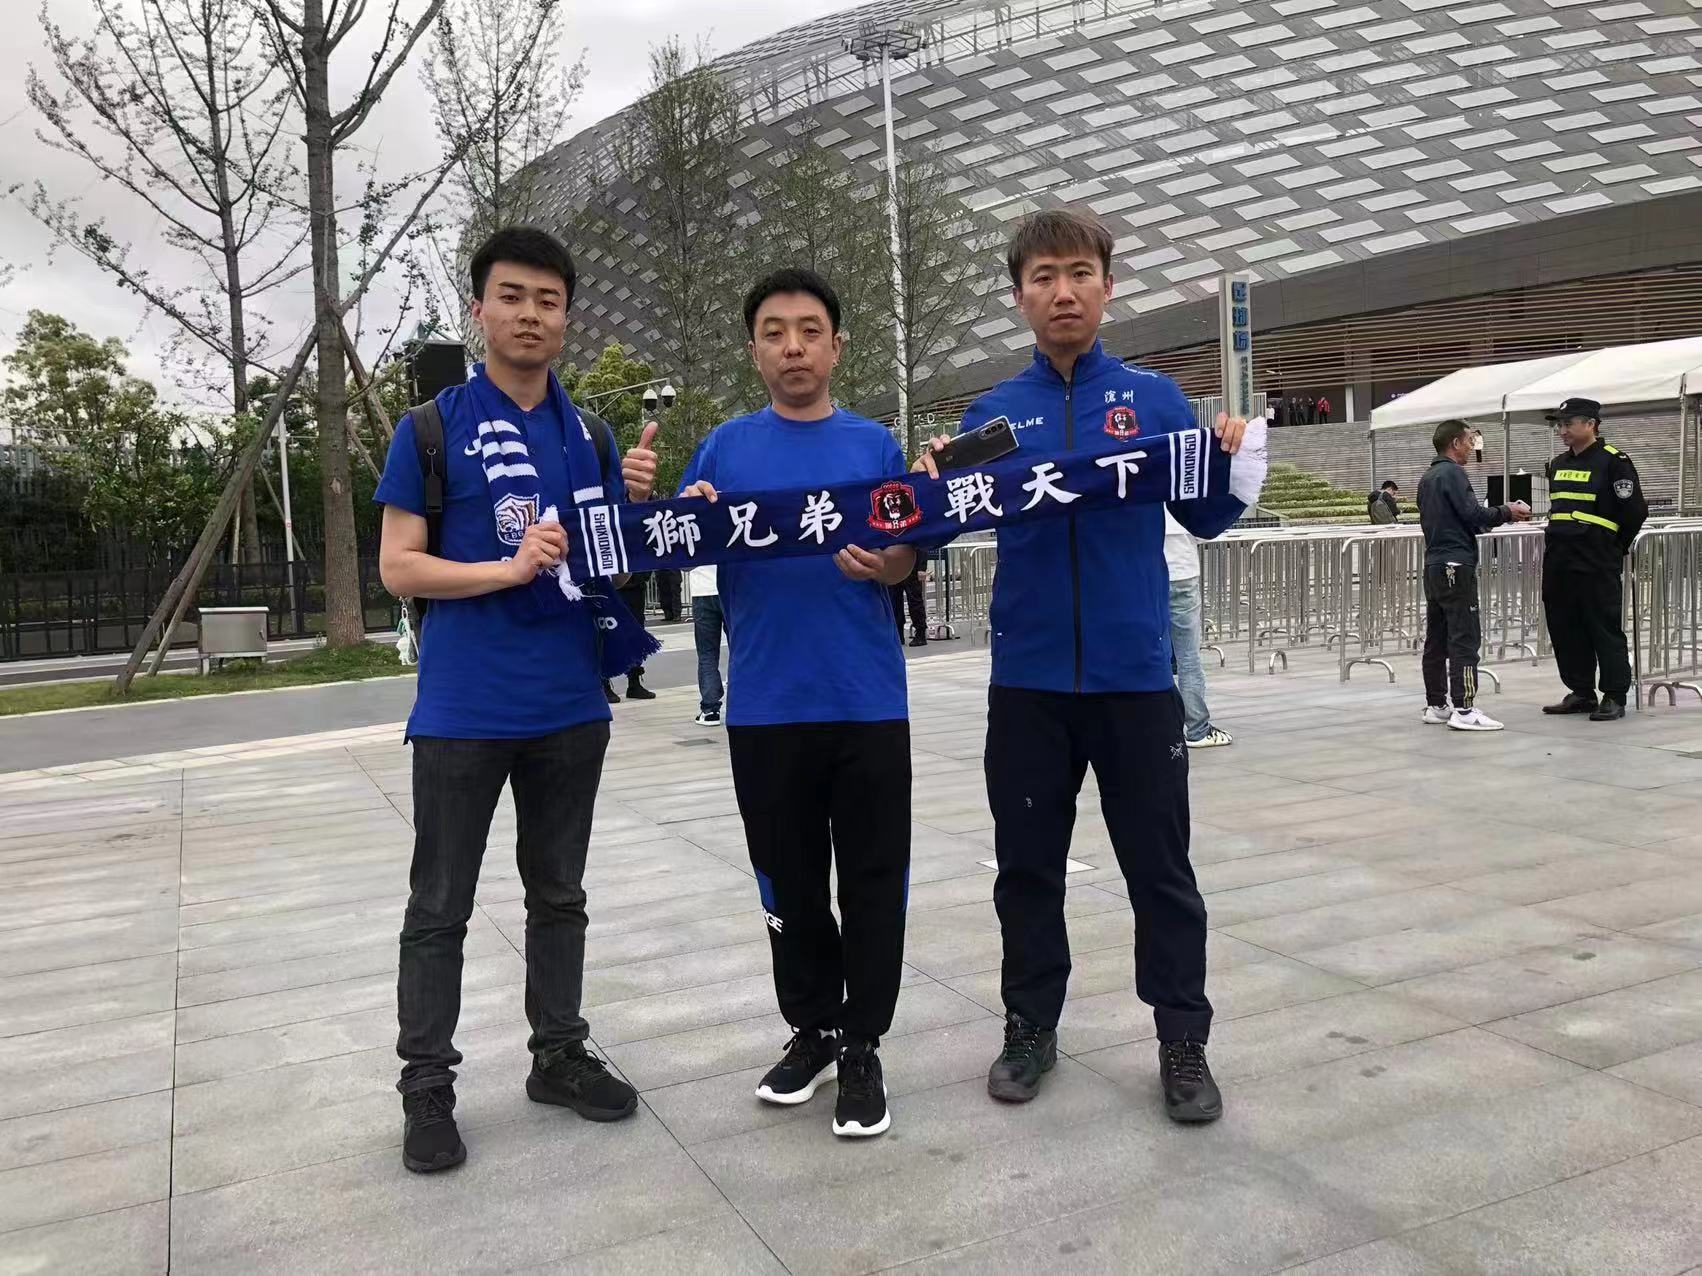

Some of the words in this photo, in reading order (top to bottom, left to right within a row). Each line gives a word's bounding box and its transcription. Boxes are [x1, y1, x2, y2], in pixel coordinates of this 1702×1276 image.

[1010, 416, 1044, 430] ELME
[1184, 433, 1197, 495] SHIXIONGDI
[643, 491, 843, 557] 獅兄弟
[944, 450, 1148, 524] 戰天下
[594, 512, 614, 570] SHIXIONGDI
